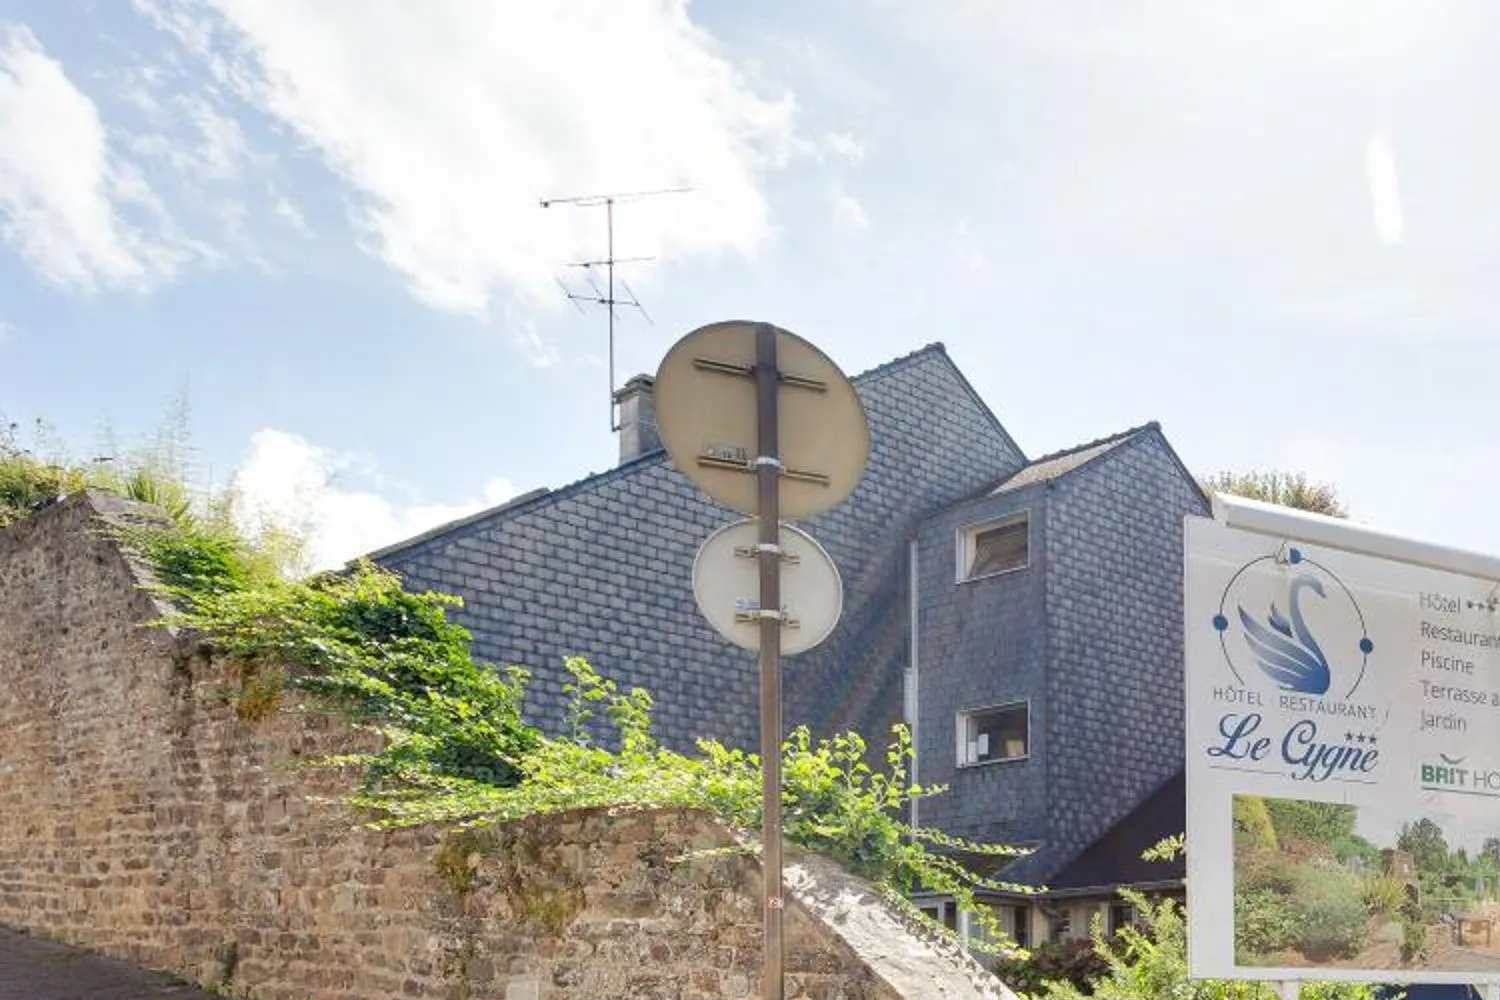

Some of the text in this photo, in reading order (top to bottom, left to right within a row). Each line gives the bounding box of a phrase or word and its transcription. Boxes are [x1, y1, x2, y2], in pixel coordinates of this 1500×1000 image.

[1419, 591, 1461, 614] Hôtel
[1421, 649, 1475, 675] Piscine
[1213, 684, 1377, 719] HÔTEL RESTAURANT
[1419, 679, 1488, 705] Terrasse
[1419, 709, 1467, 732] Jardin
[1207, 713, 1379, 782] Le Cygne
[1421, 764, 1469, 787] BRIT
